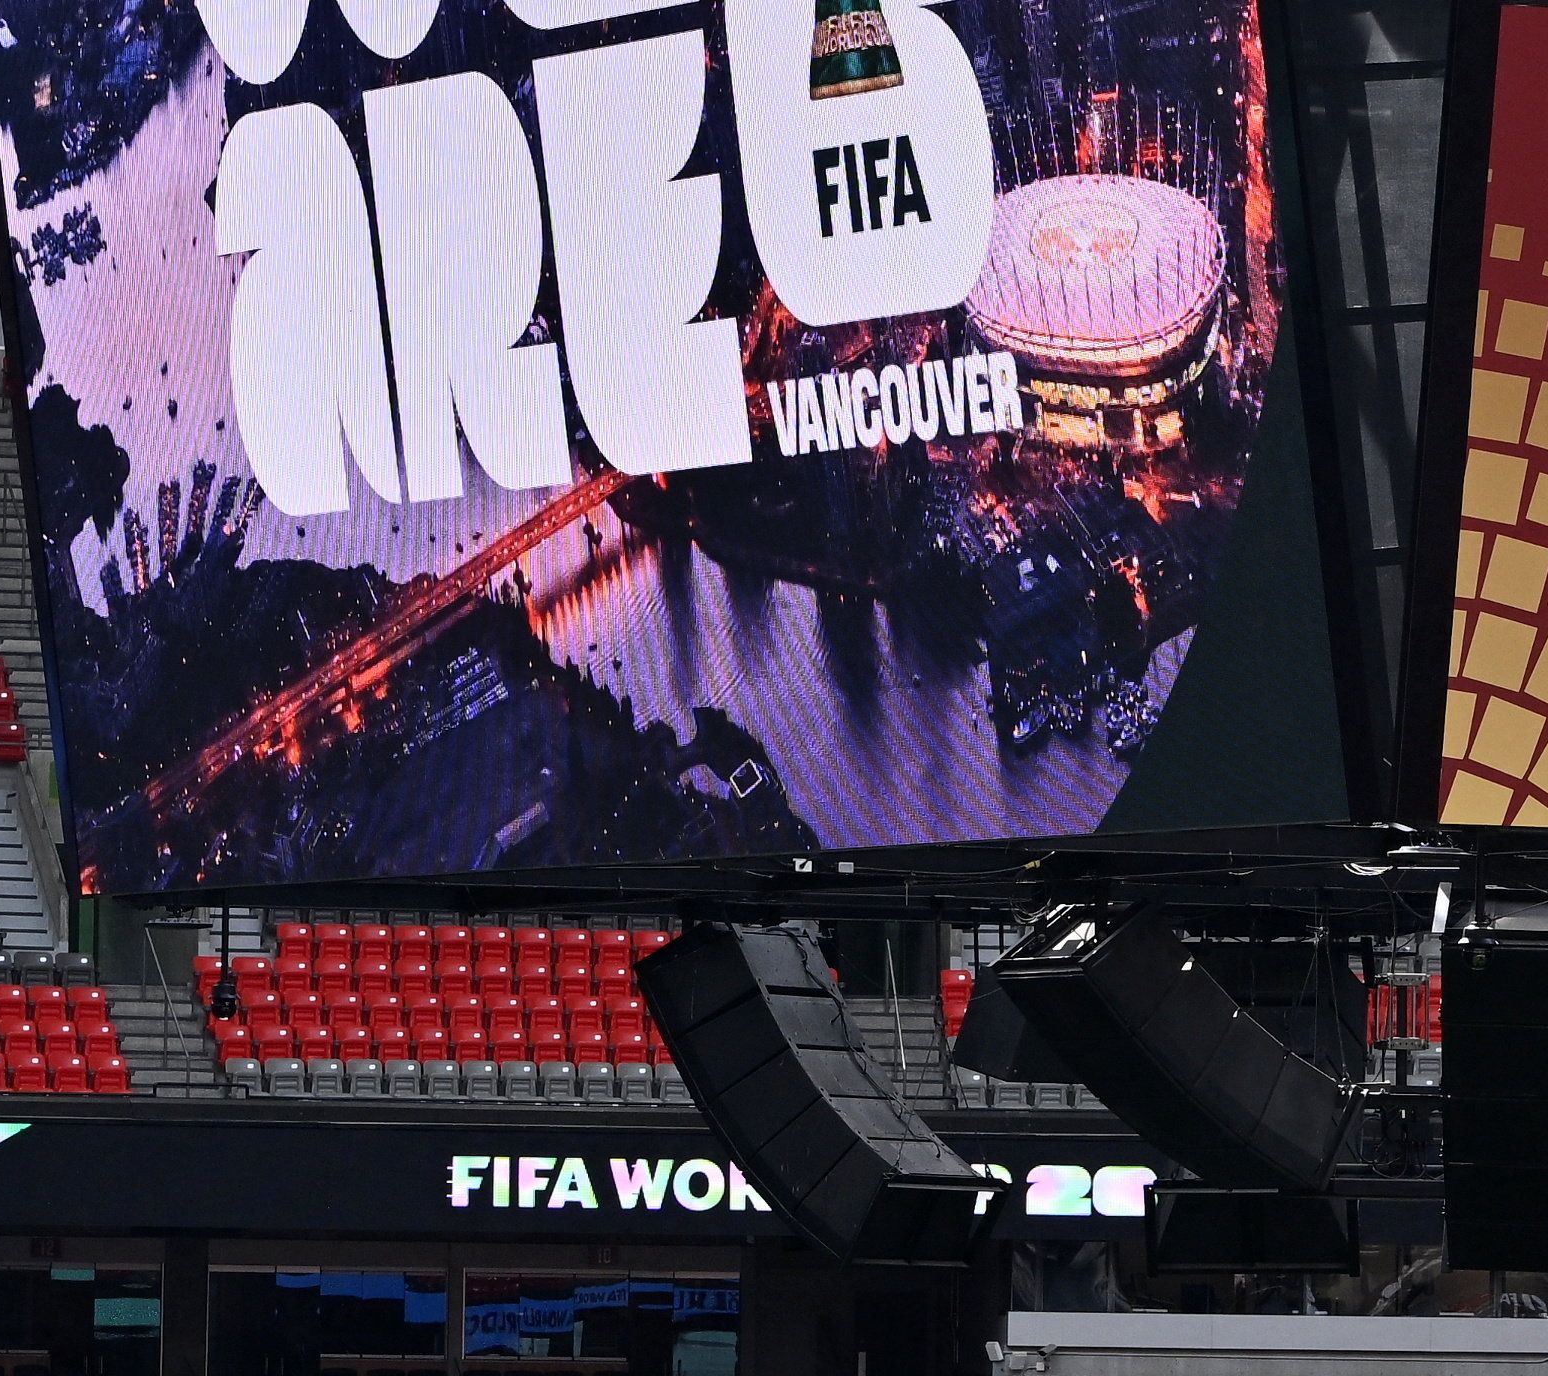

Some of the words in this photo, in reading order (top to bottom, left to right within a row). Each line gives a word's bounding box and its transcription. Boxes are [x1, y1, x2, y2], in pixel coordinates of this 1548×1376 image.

[813, 136, 931, 237] FIFA
[767, 353, 1020, 457] VANCOUVER
[447, 1156, 598, 1208] FIFA
